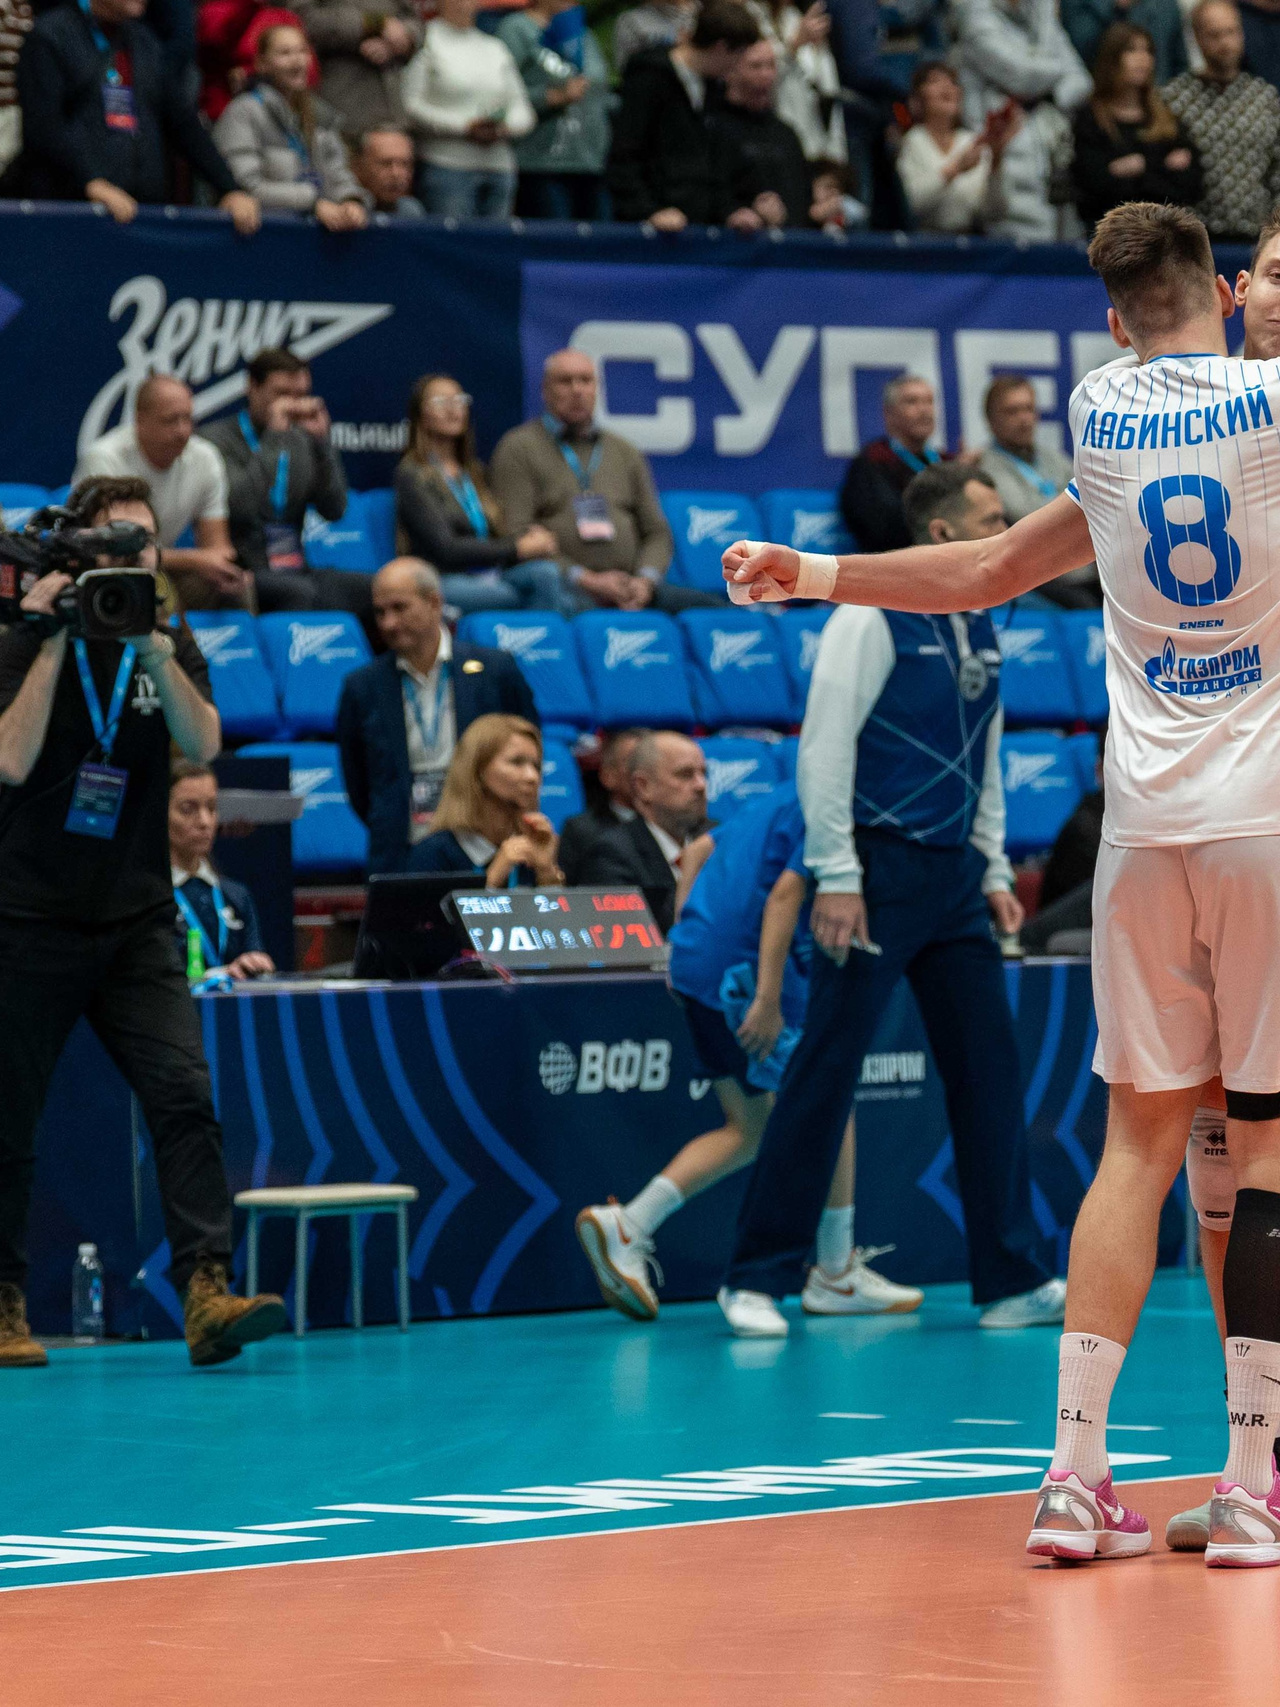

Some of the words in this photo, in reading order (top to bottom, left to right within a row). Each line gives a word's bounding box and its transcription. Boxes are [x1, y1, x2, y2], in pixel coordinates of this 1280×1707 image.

[1081, 384, 1274, 450] ЛАБИНСКИЙ
[1137, 474, 1242, 607] 8
[1179, 619, 1225, 630] ENSEN
[1178, 644, 1261, 680] ГАЗПРОМ
[1181, 670, 1261, 694] ТРАНСГАЗ
[576, 1038, 673, 1095] ВФВ
[1204, 1146, 1230, 1156] erre
[1060, 1408, 1092, 1424] C.L.
